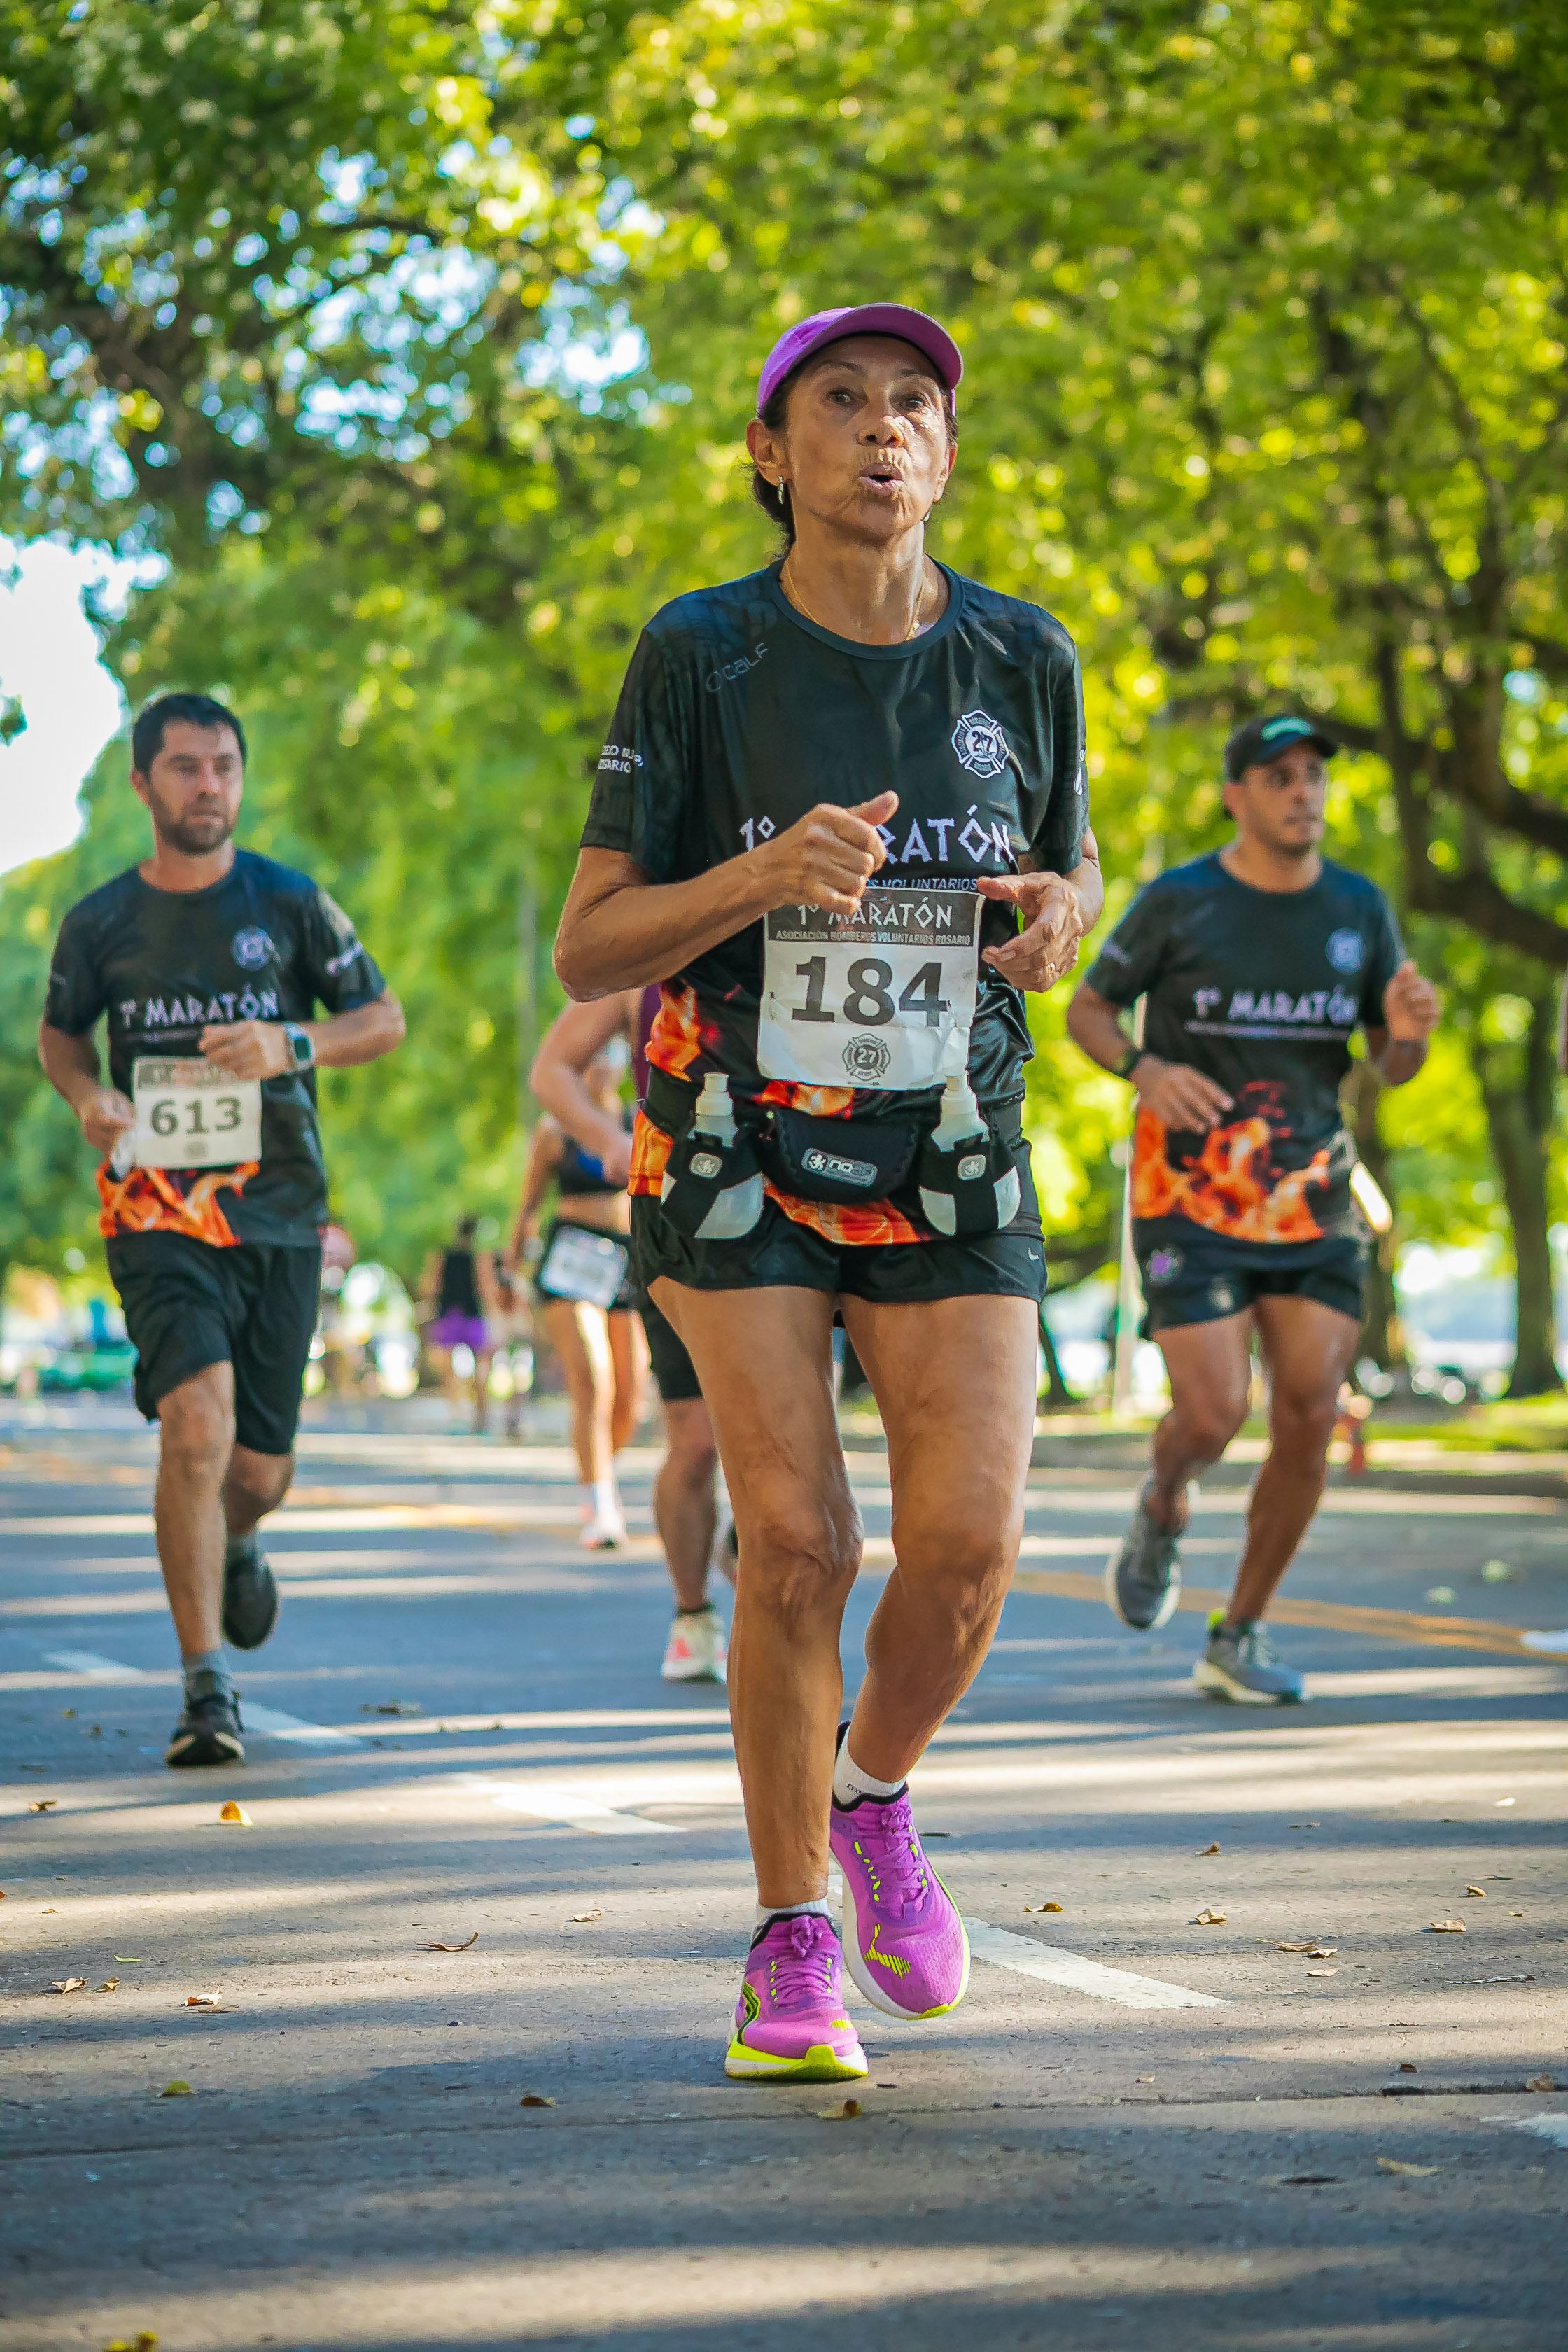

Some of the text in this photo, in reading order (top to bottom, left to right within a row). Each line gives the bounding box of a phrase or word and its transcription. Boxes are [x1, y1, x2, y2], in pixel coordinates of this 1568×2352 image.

[971, 730, 993, 752] 27
[877, 932, 934, 944] VOLUNTARIOS
[935, 934, 972, 946] ROSARIO
[144, 982, 279, 1028] MARATÓN
[791, 955, 948, 1028] 184
[857, 1046, 877, 1064] 27
[150, 1096, 242, 1137] 613
